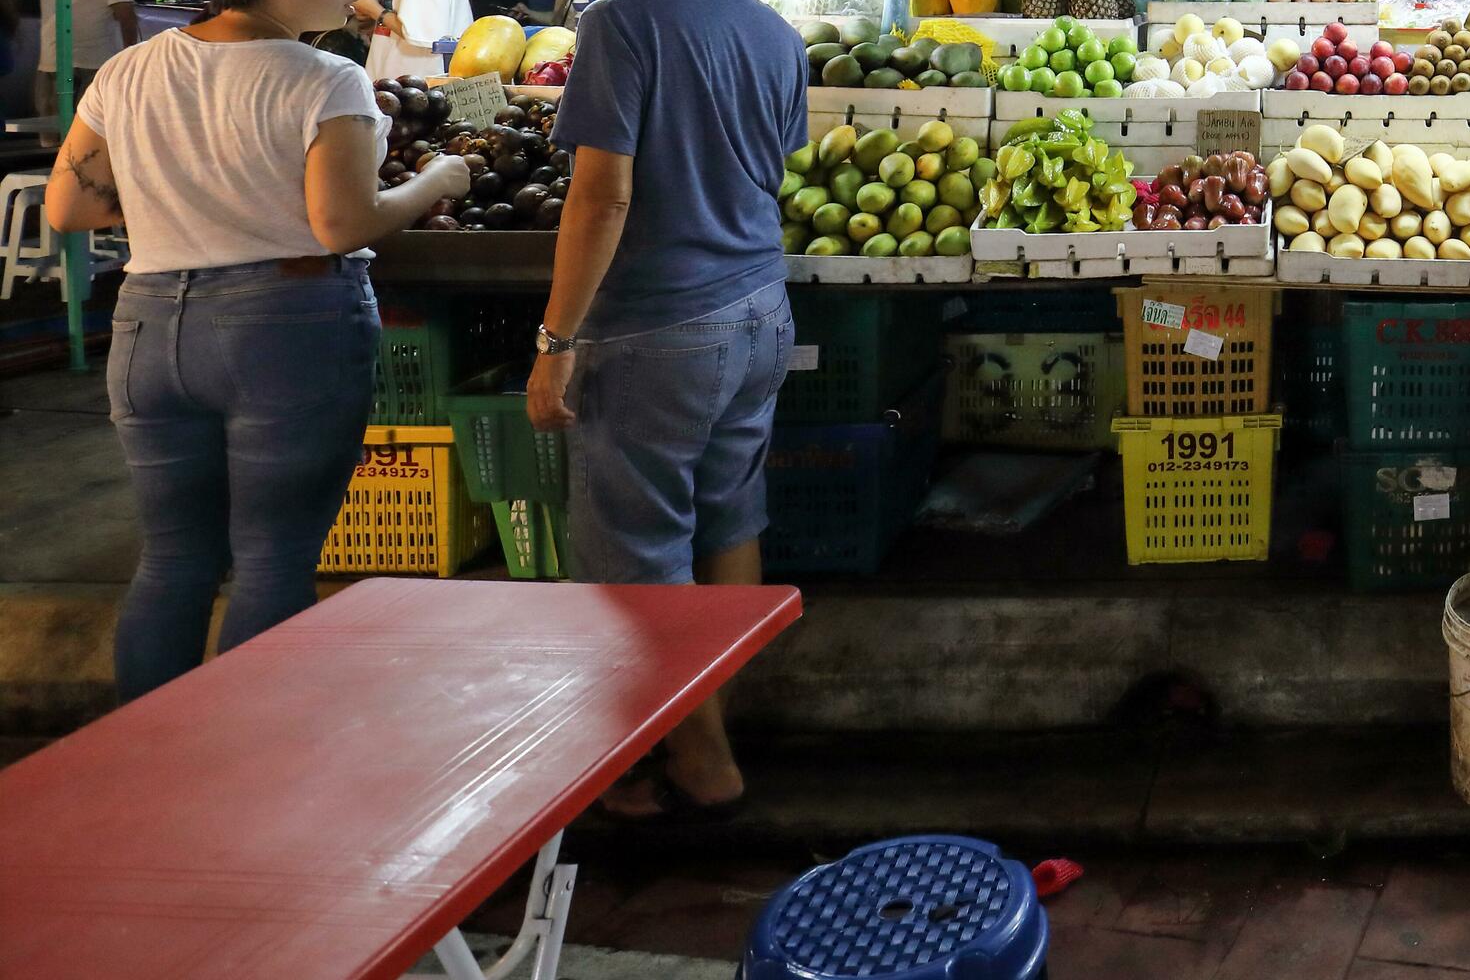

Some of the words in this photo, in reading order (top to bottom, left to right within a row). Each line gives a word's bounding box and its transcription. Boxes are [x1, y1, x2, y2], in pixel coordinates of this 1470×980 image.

[465, 108, 492, 120] KILO
[1161, 432, 1235, 460] 1991
[1148, 460, 1249, 473] 012-2349173
